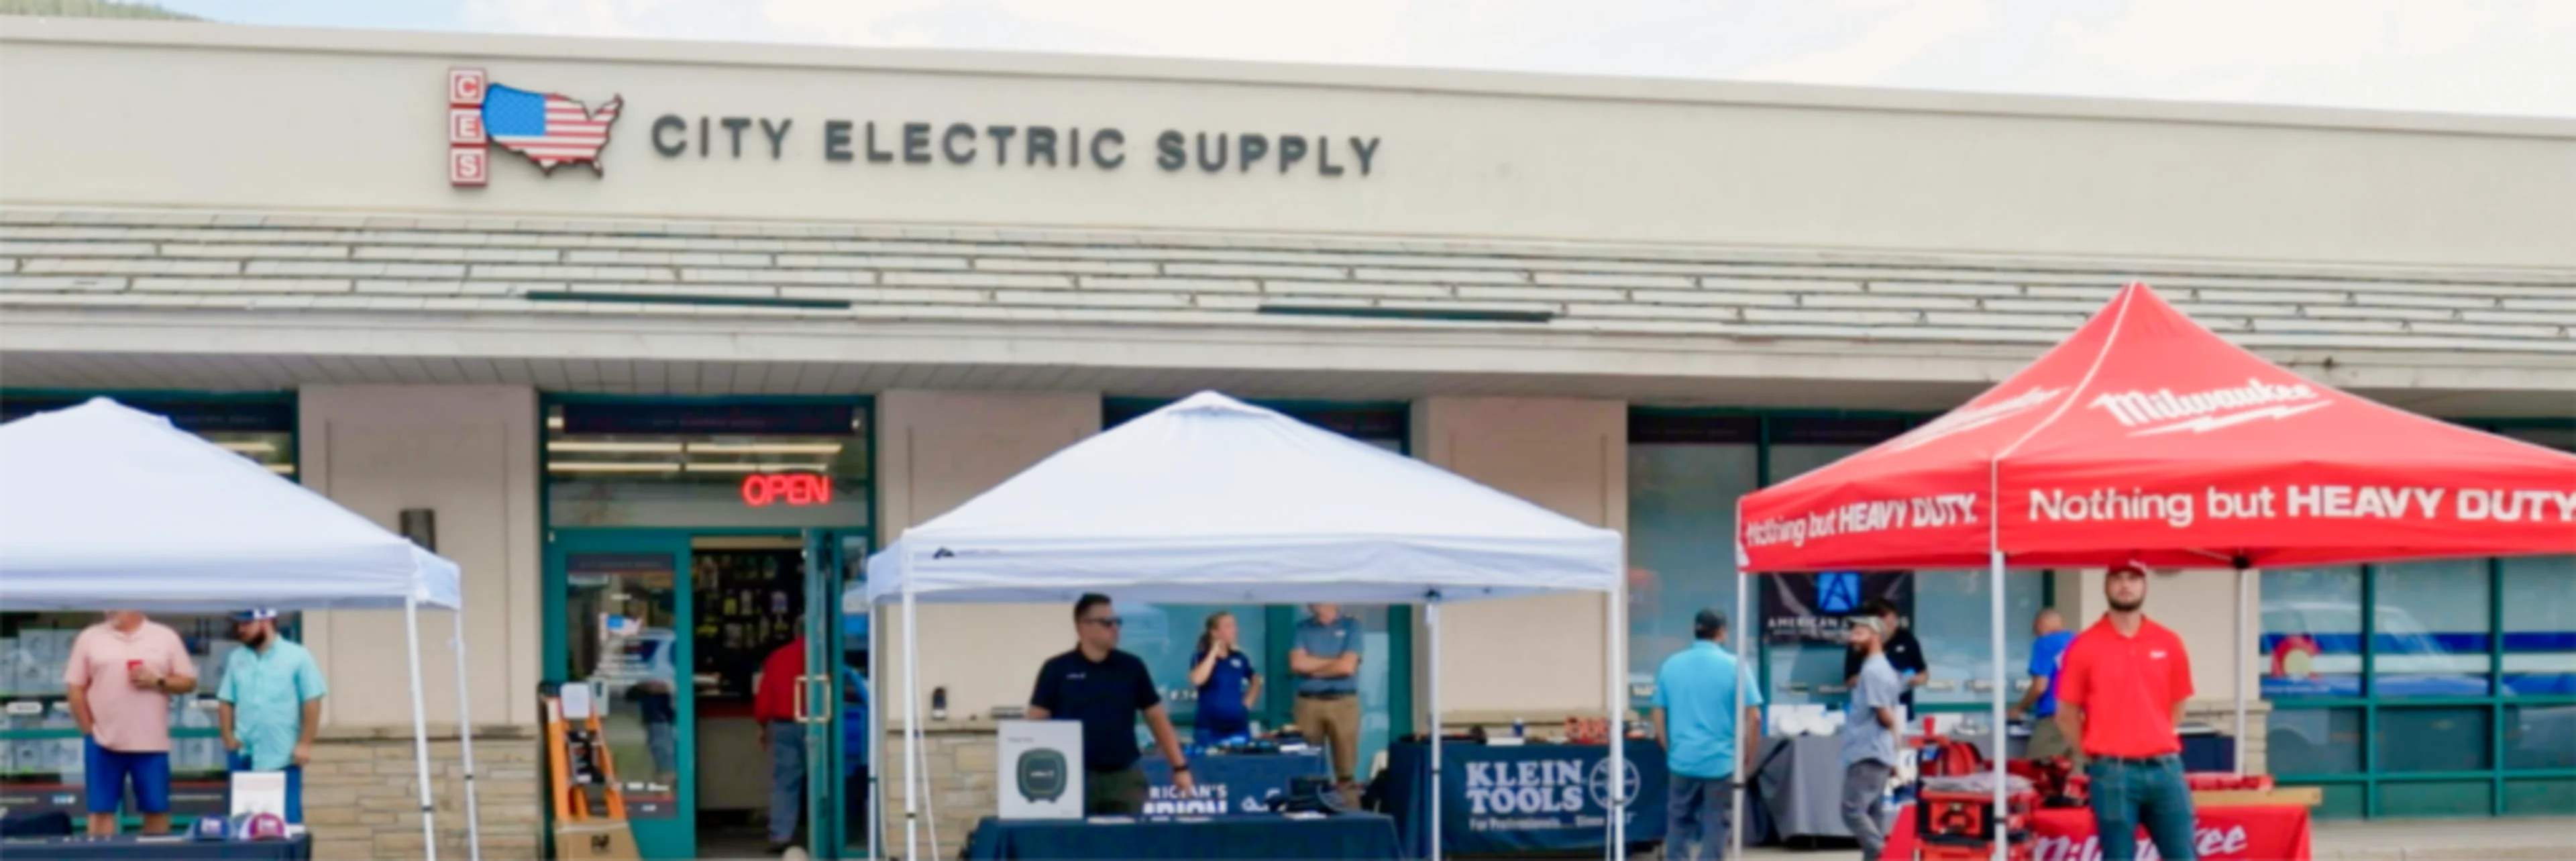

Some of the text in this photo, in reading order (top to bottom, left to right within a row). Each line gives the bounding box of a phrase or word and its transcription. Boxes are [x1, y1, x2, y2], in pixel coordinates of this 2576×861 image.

[651, 115, 1381, 176] CITY ELECTRIC SUPPLY
[2086, 377, 2318, 427] Milwaukee
[742, 474, 832, 507] OPEN
[2029, 489, 2194, 527] Nothing
[2207, 487, 2275, 518] but
[2287, 486, 2446, 519] HEAVY
[1748, 515, 1806, 548] Nothing
[1809, 511, 1838, 538] but
[1839, 499, 1907, 533] HEAVY
[1465, 760, 1583, 787] KLEIN
[1465, 787, 1584, 814] TOOLS
